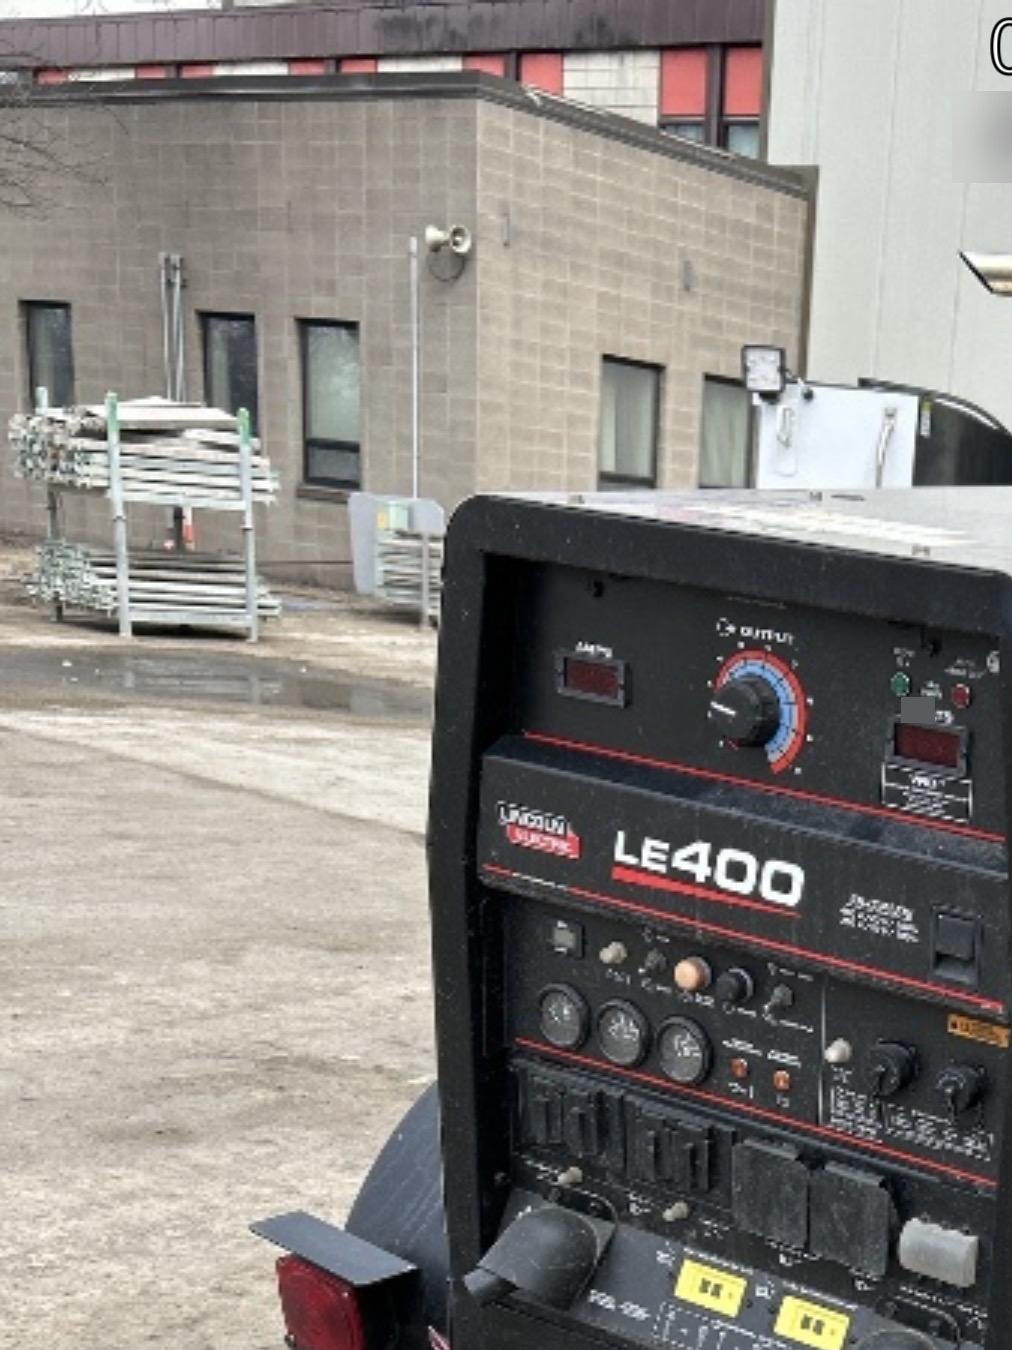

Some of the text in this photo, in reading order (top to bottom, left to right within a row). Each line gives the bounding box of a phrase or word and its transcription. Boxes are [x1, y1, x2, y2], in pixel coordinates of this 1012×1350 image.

[740, 626, 797, 645] OUTPUT
[499, 804, 566, 835] LINCOLN
[613, 830, 806, 907] LE400
